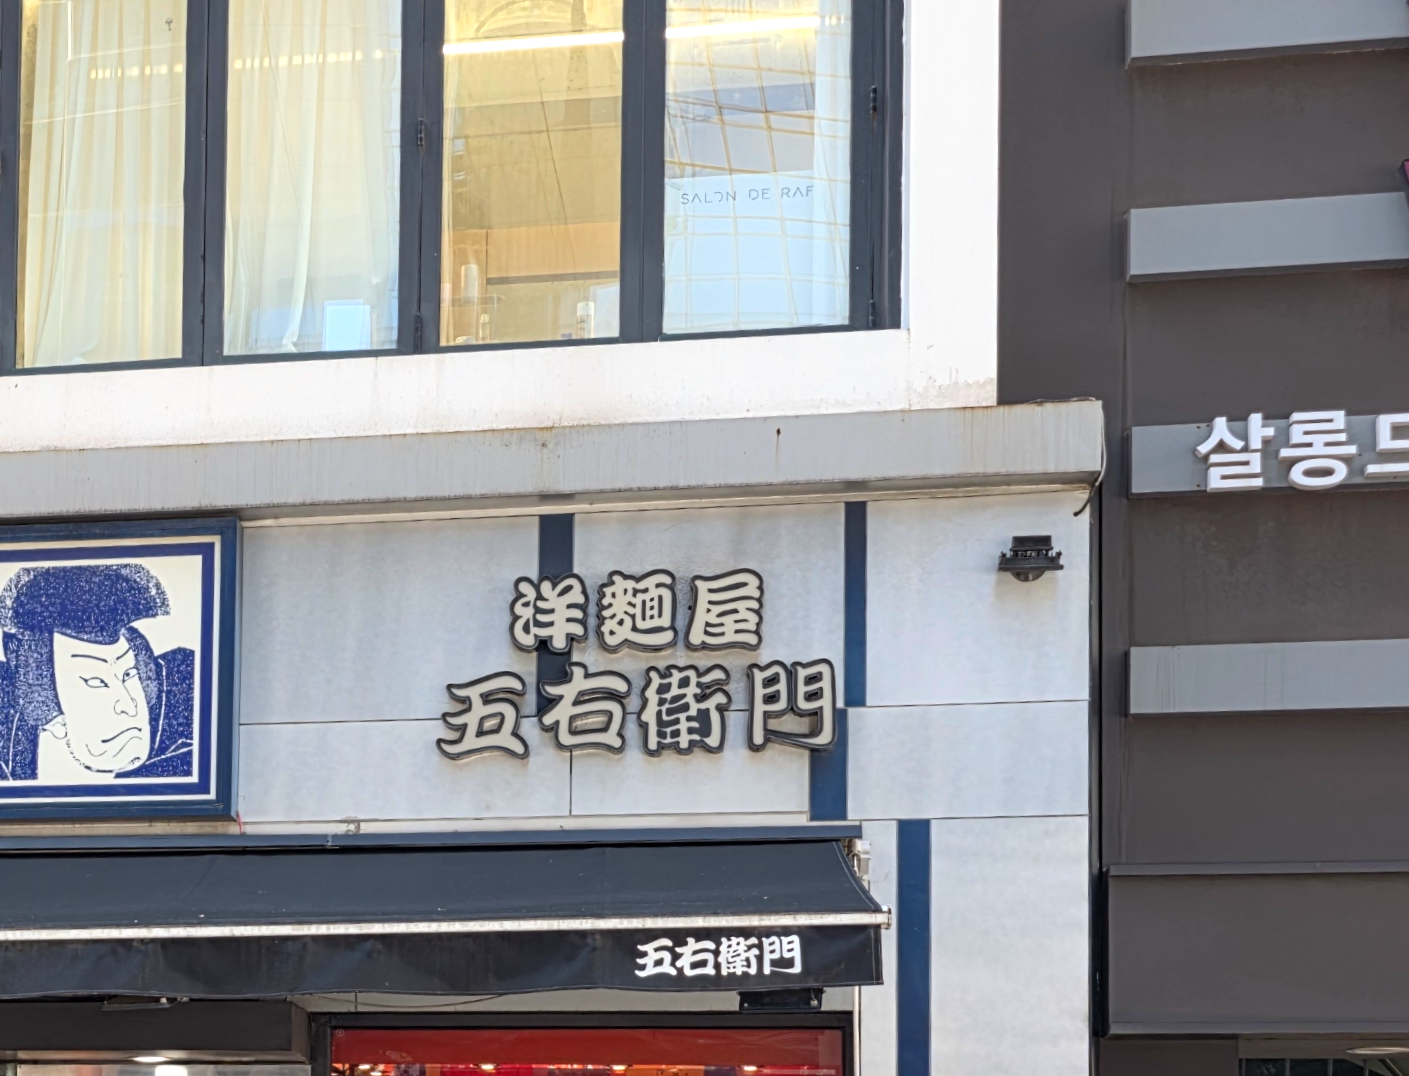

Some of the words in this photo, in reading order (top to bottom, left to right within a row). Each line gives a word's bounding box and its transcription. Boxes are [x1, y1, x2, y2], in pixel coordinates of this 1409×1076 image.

[680, 188, 737, 205] SALON
[748, 187, 771, 201] DE
[435, 656, 839, 761] 五右衛門
[634, 934, 802, 978] 五右衛門
